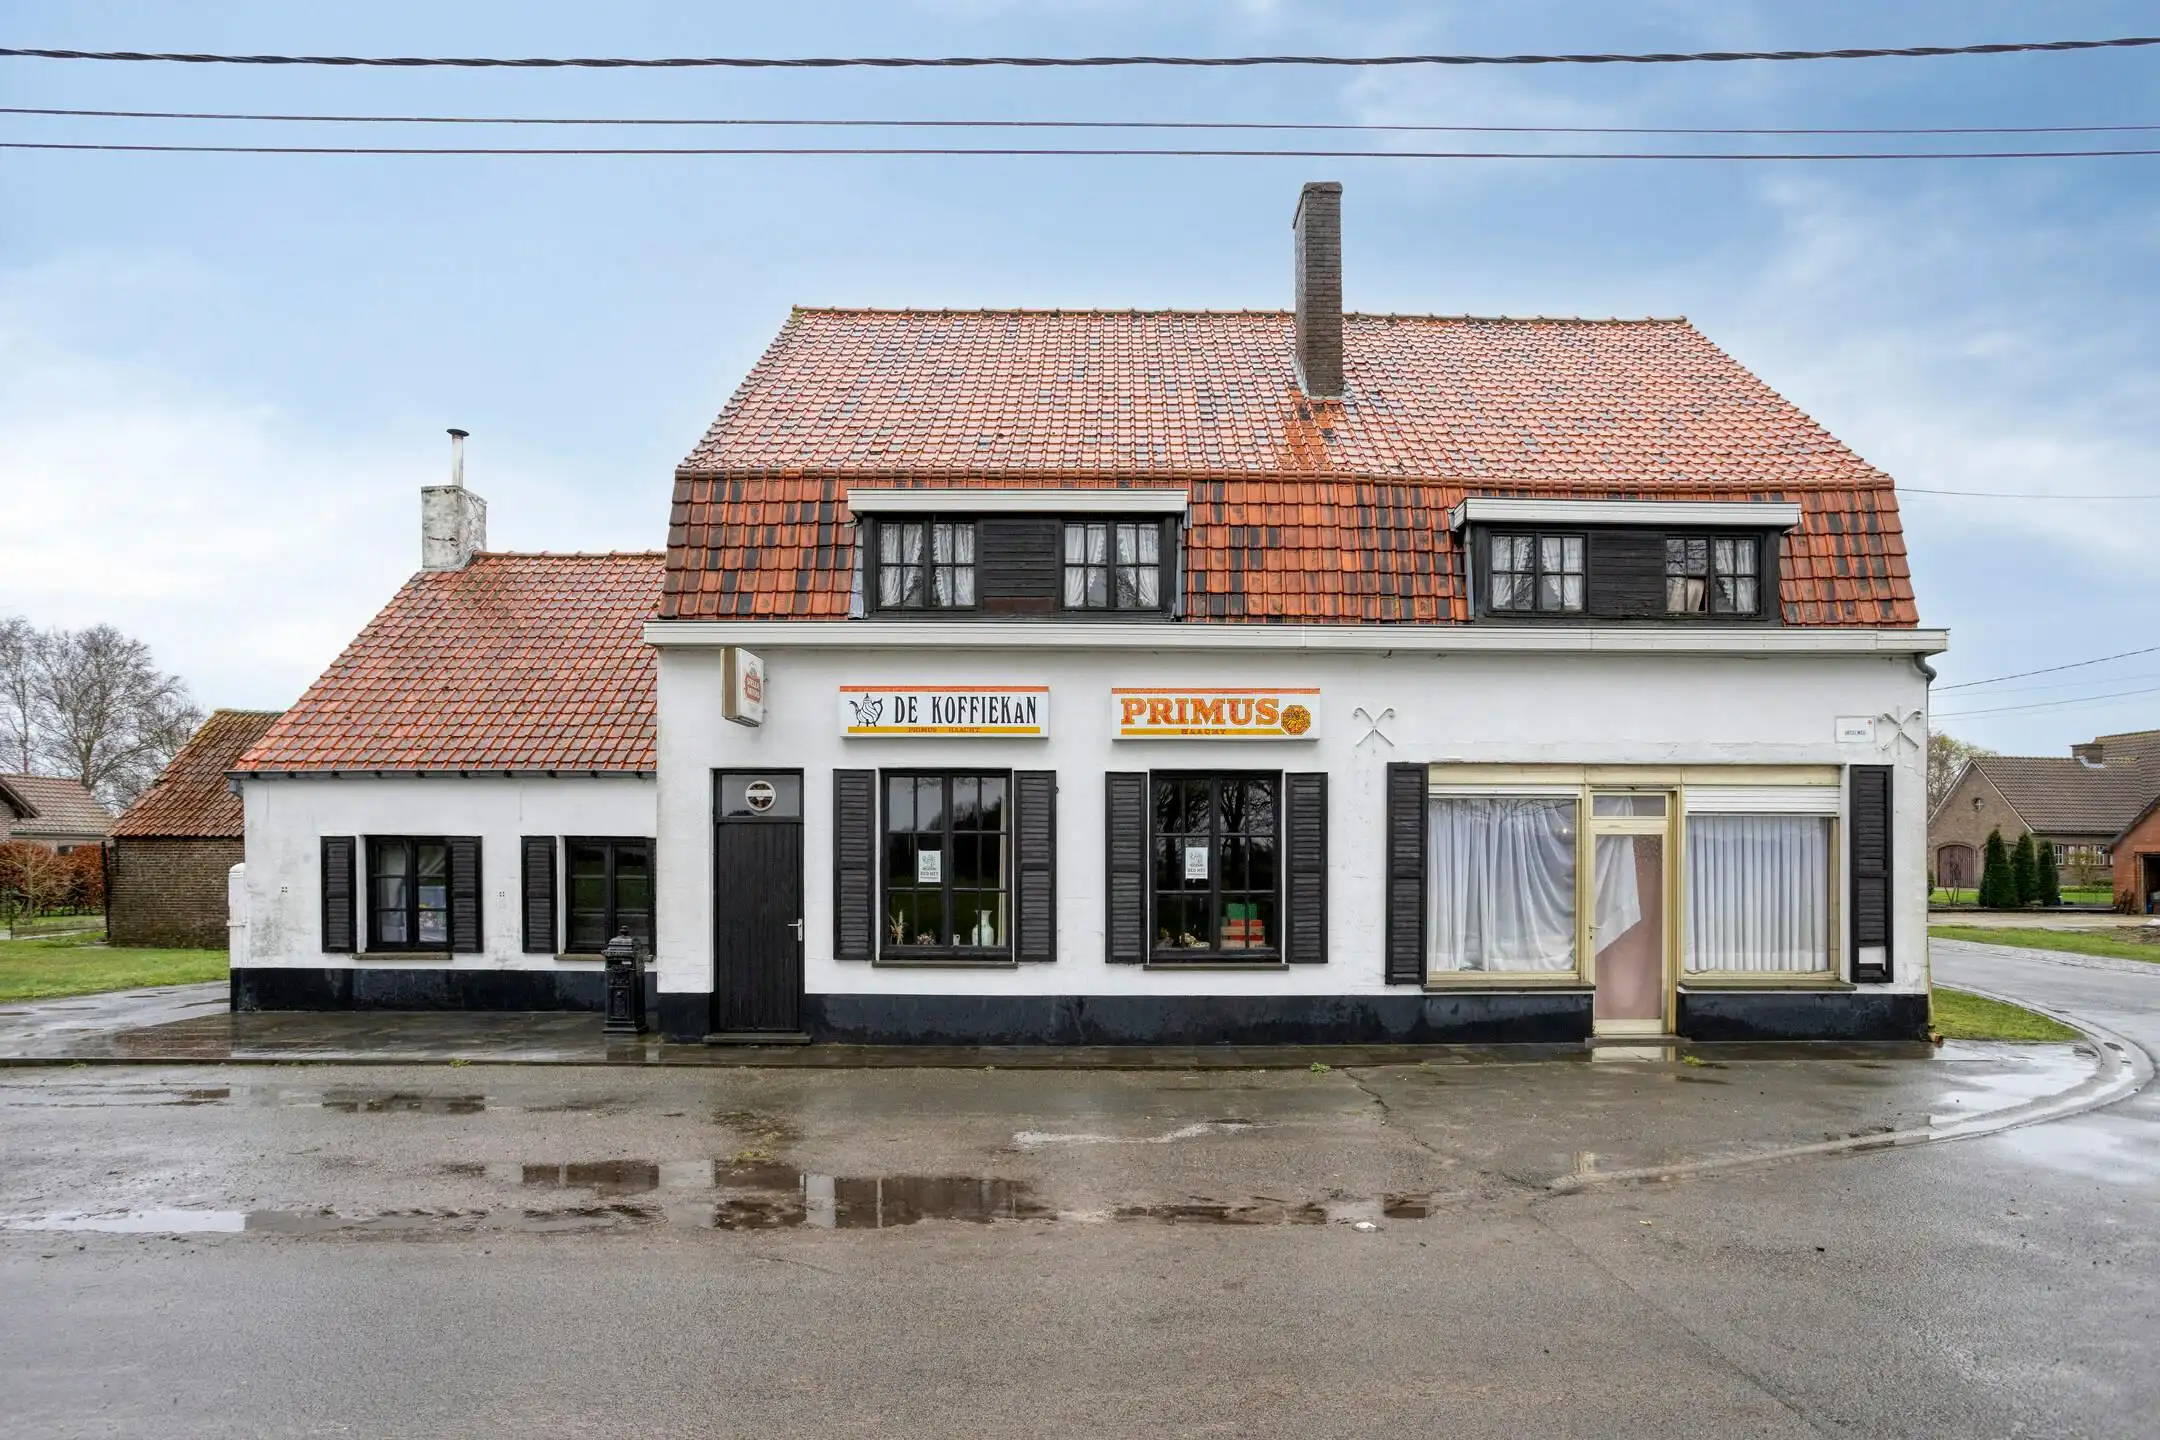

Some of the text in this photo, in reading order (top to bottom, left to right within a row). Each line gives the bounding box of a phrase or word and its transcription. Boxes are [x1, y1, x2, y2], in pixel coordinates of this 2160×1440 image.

[895, 696, 1037, 724] DE KOFFIEKAN
[1121, 698, 1280, 725] PRIMUS
